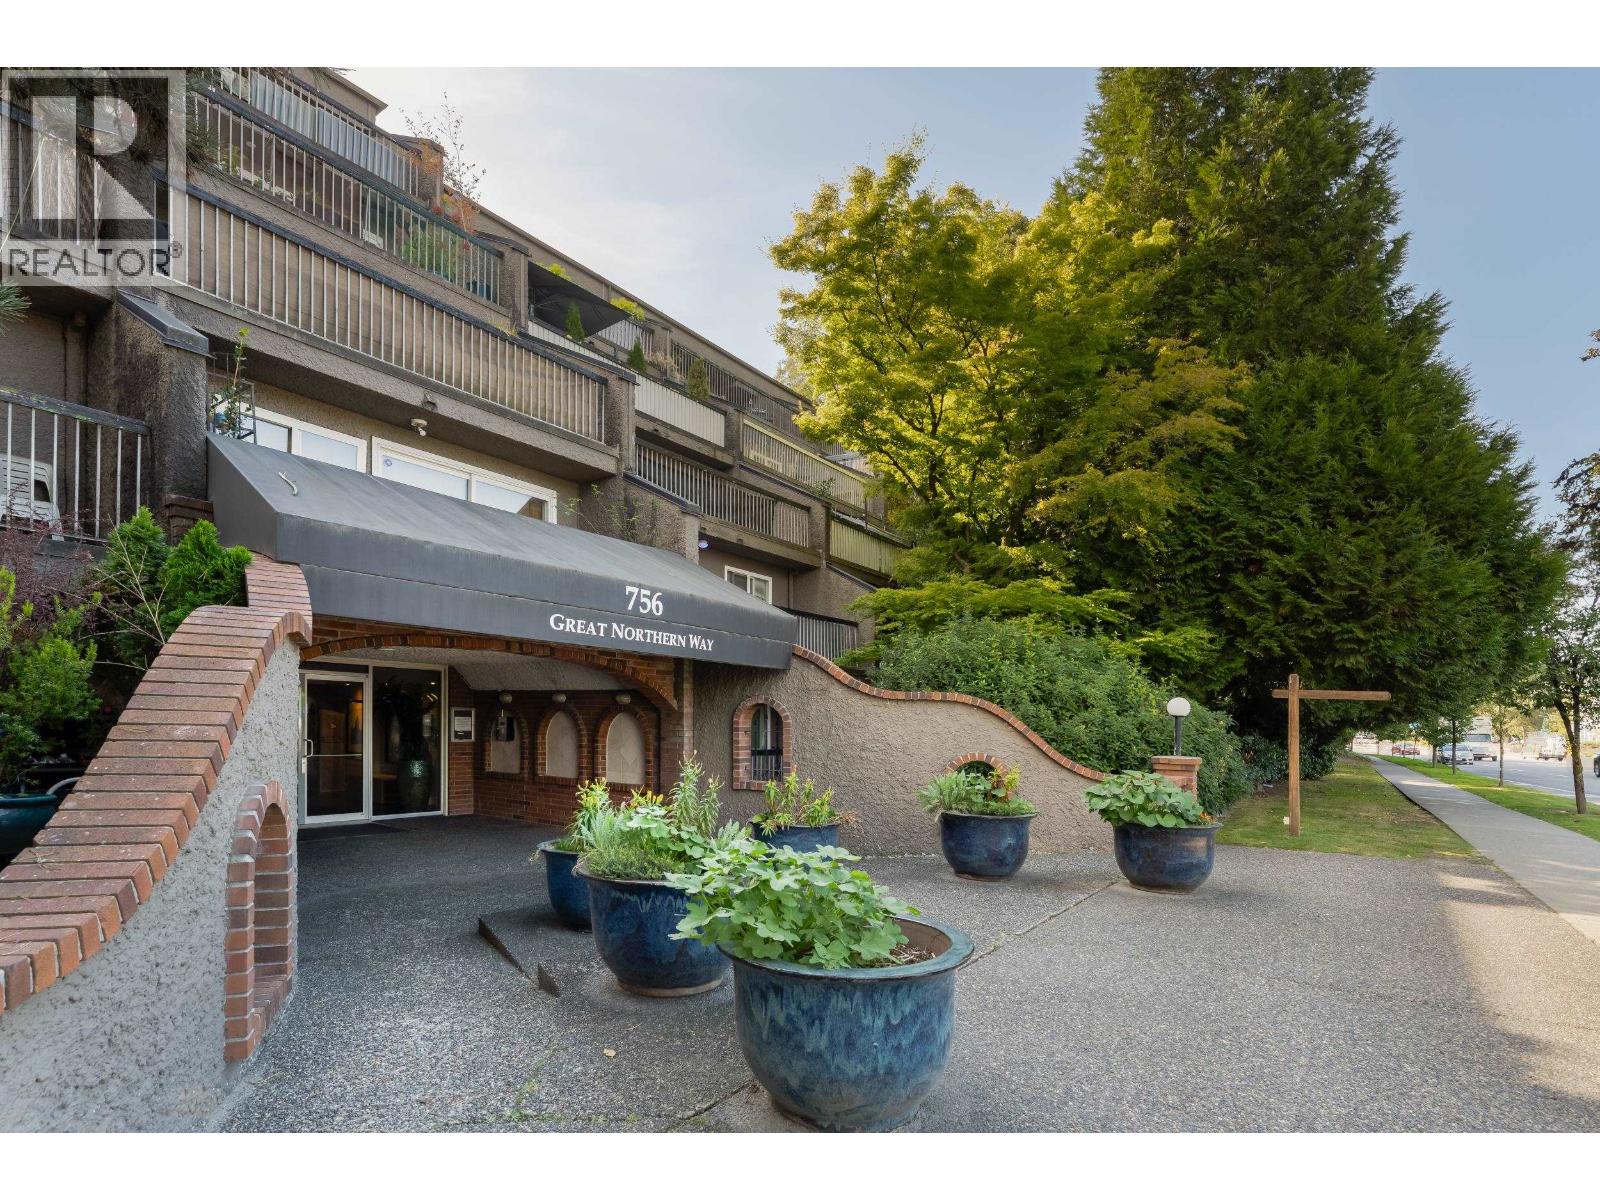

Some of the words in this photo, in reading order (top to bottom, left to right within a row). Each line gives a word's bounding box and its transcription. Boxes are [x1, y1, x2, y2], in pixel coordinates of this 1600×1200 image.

[625, 586, 663, 616] 756
[549, 613, 607, 637] GREAT
[611, 622, 686, 648] NORTHERN
[689, 634, 714, 651] WAY
